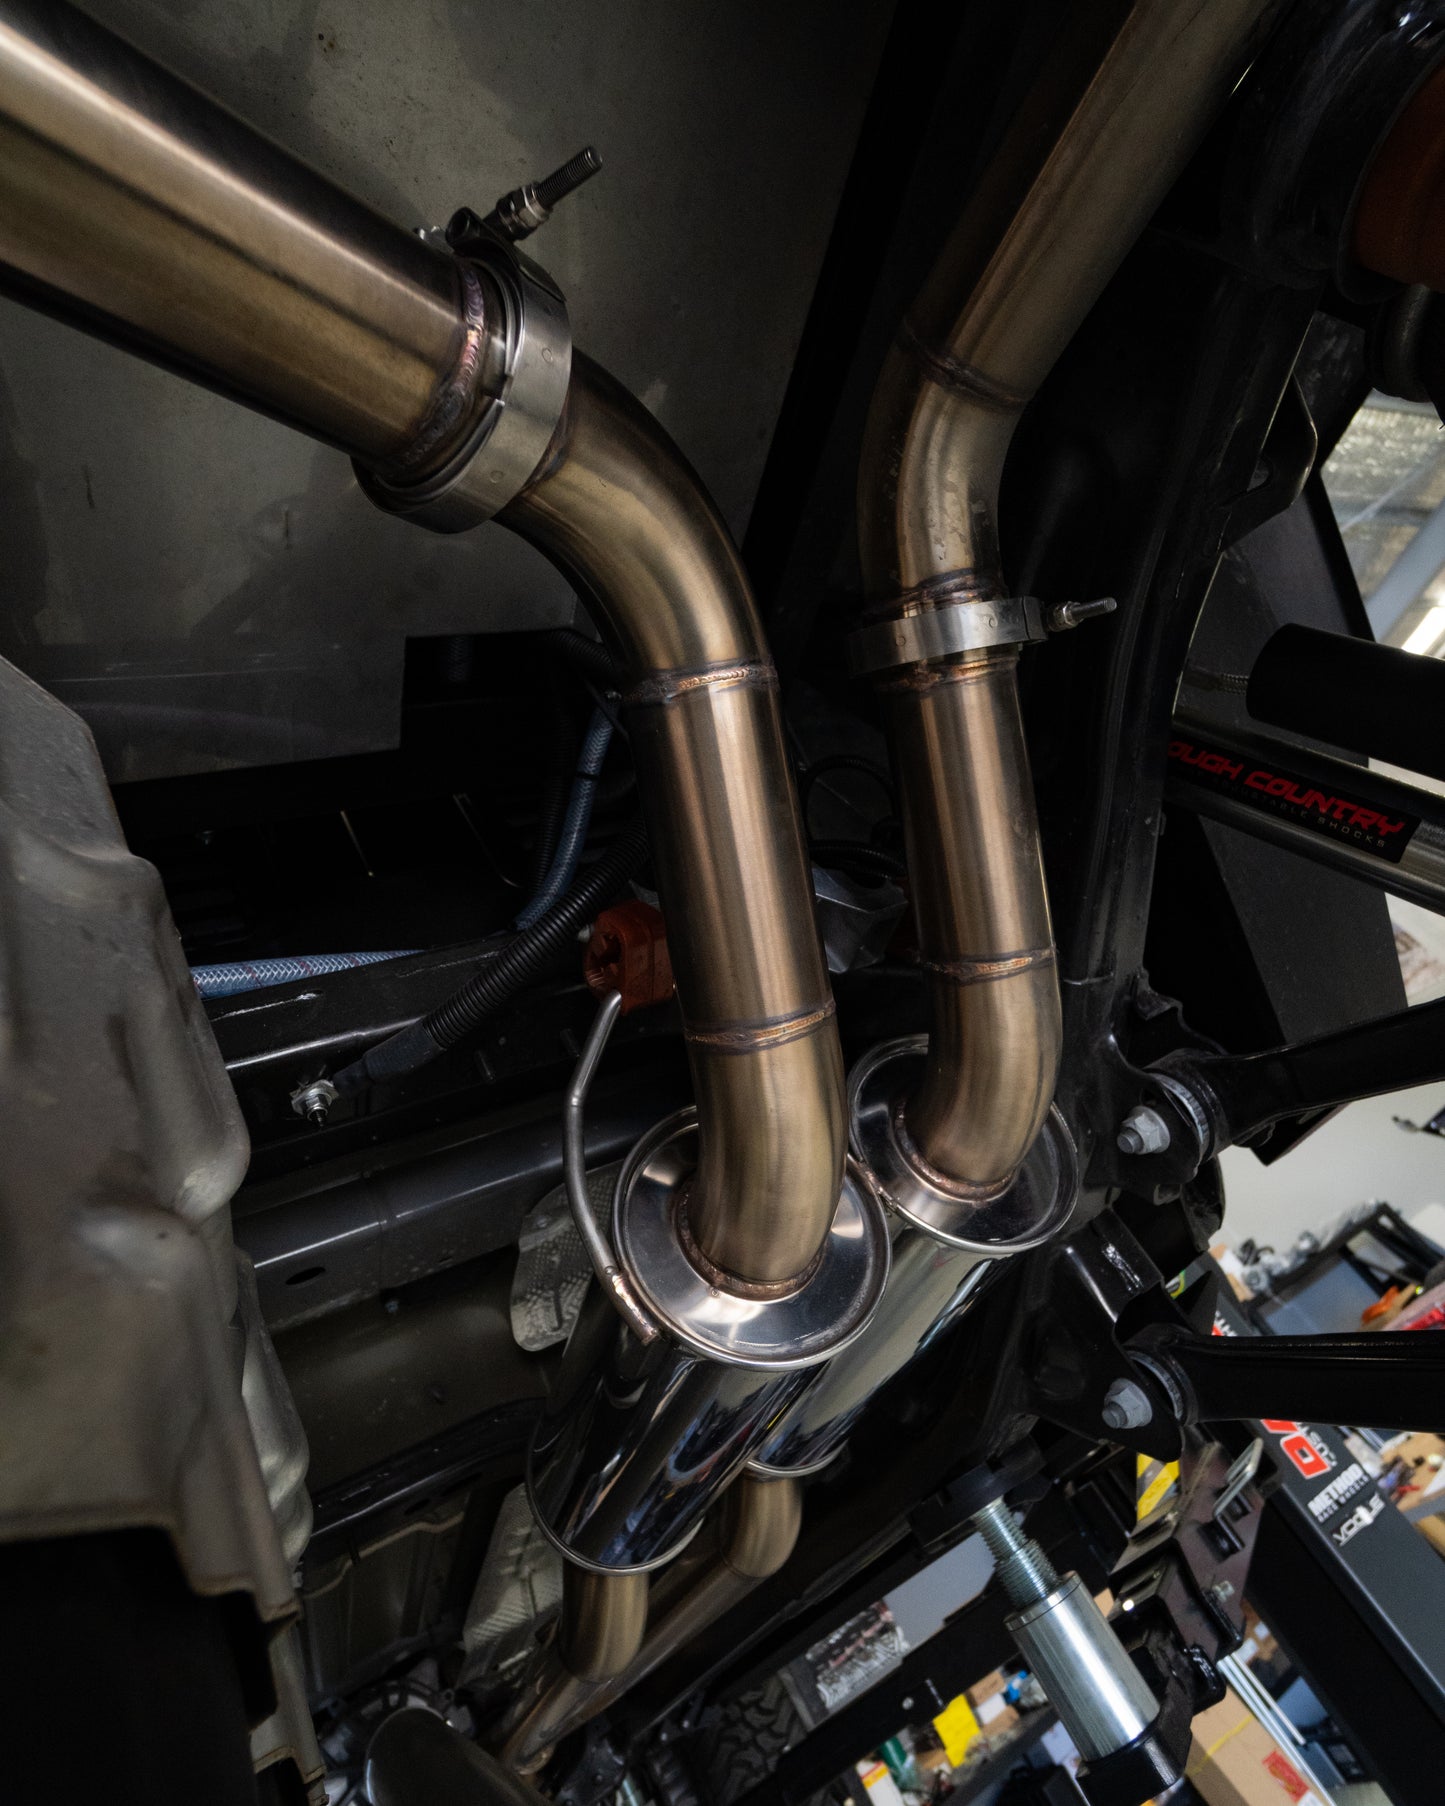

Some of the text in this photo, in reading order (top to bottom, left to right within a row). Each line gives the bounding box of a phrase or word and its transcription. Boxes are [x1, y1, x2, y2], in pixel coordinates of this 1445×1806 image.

[1167, 740, 1406, 837] OUGH COUNTRY
[1317, 816, 1386, 848] SHOCKS
[1307, 1463, 1363, 1518] METHOD
